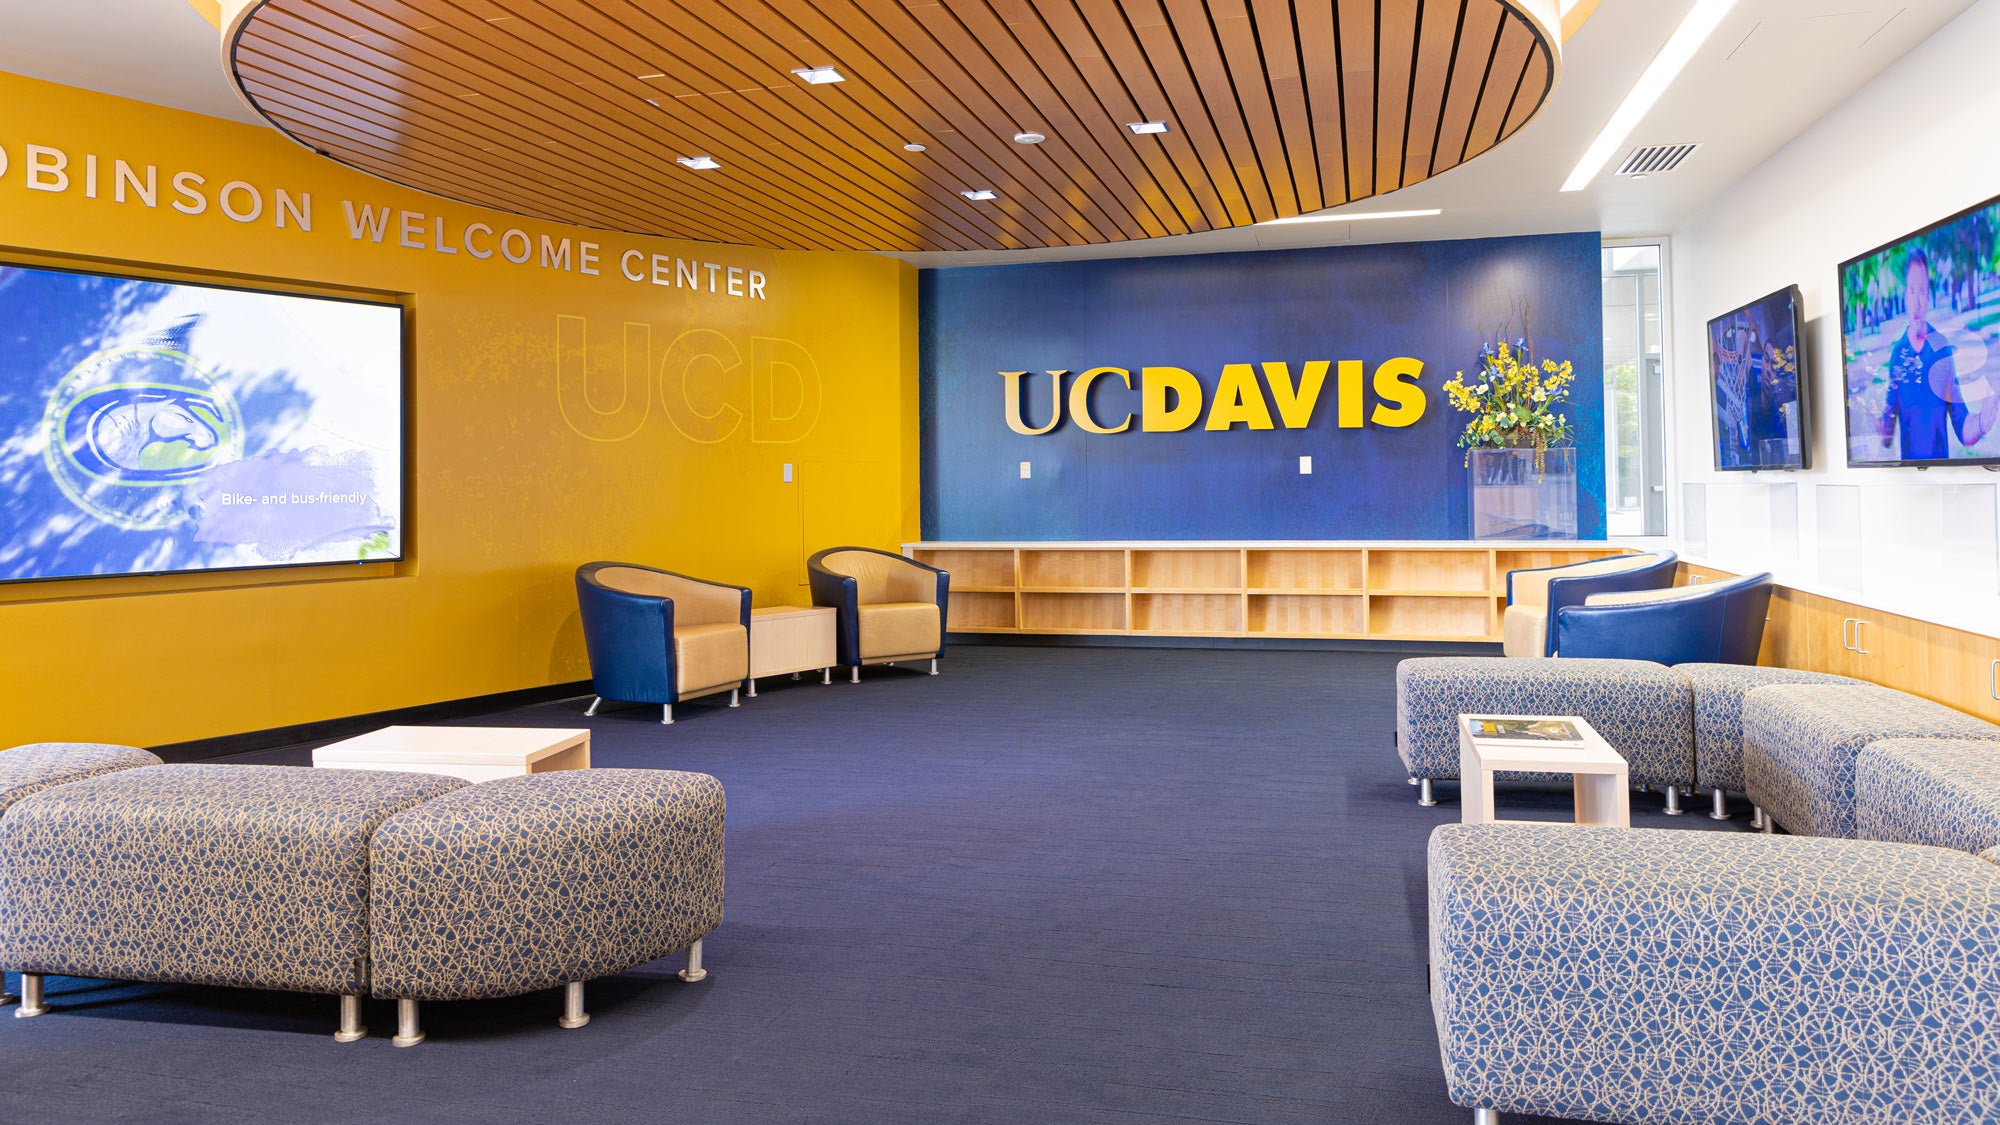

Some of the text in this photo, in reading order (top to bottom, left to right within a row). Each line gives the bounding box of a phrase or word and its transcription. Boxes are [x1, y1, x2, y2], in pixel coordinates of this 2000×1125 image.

[0, 143, 767, 300] BINSON WELCOME CENTER
[556, 314, 822, 444] UCD
[221, 491, 367, 505] Bike- and bus-friendly
